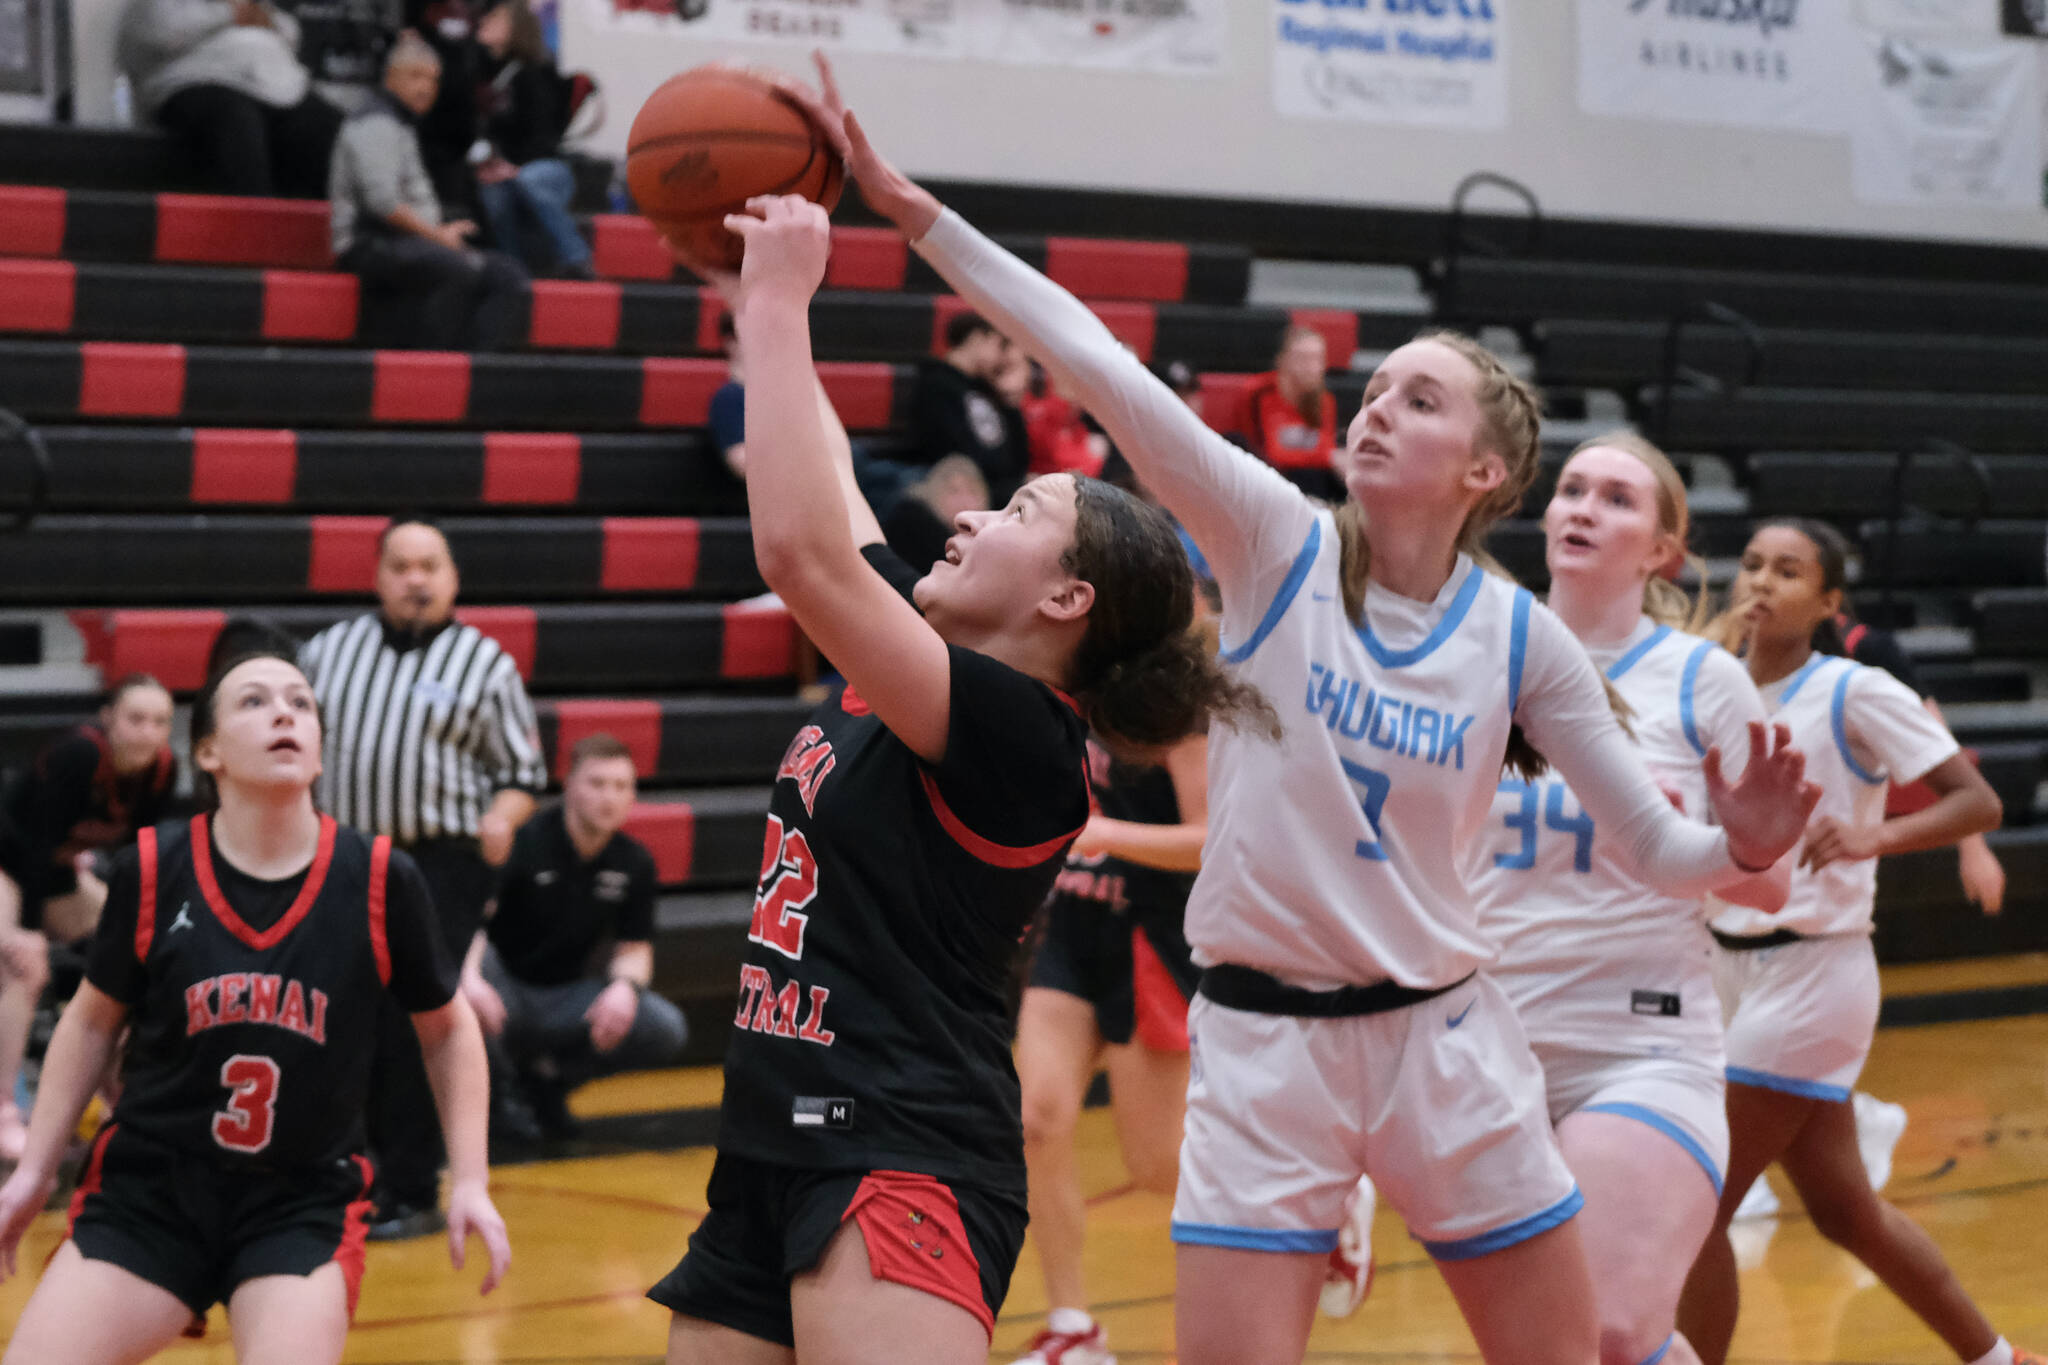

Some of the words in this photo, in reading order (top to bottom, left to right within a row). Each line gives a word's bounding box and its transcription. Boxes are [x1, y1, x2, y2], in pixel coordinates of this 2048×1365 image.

[1494, 779, 1595, 873] 34
[184, 972, 328, 1046] KENAI
[734, 963, 836, 1047] TRAL
[211, 1054, 281, 1154] 3
[832, 1104, 846, 1121] M
